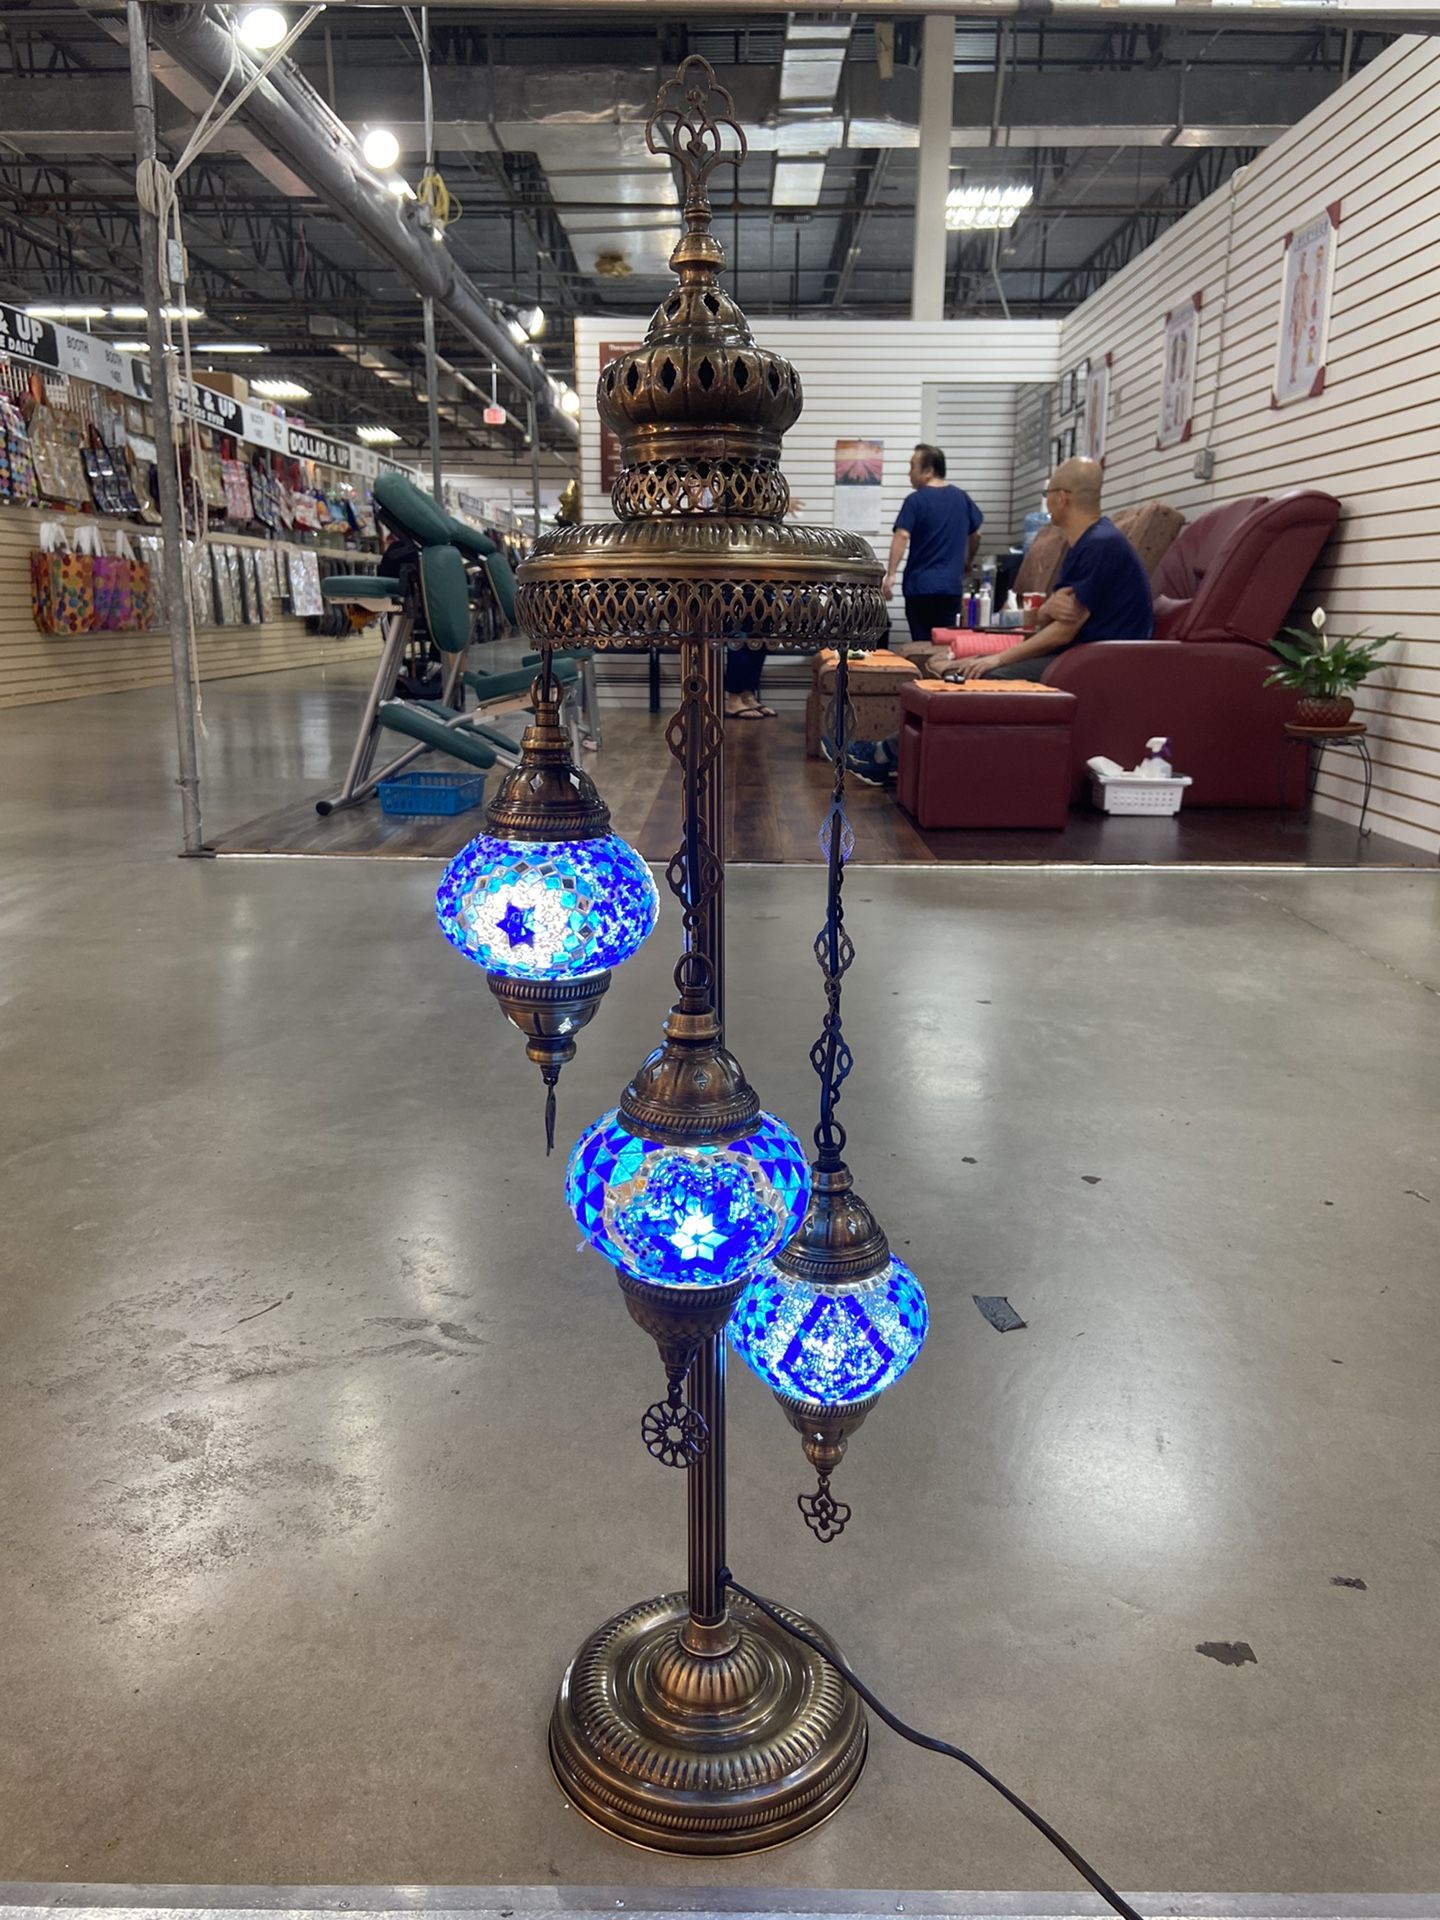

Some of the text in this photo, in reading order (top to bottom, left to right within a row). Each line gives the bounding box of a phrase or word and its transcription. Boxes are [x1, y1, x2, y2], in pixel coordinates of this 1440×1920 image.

[15, 313, 43, 344] UP
[8, 337, 35, 357] DAILY
[66, 335, 90, 354] BOOTH
[204, 391, 216, 412] &
[218, 397, 236, 420] UP
[290, 431, 328, 462] DOLLAR
[329, 444, 336, 462] &
[337, 447, 349, 466] UP
